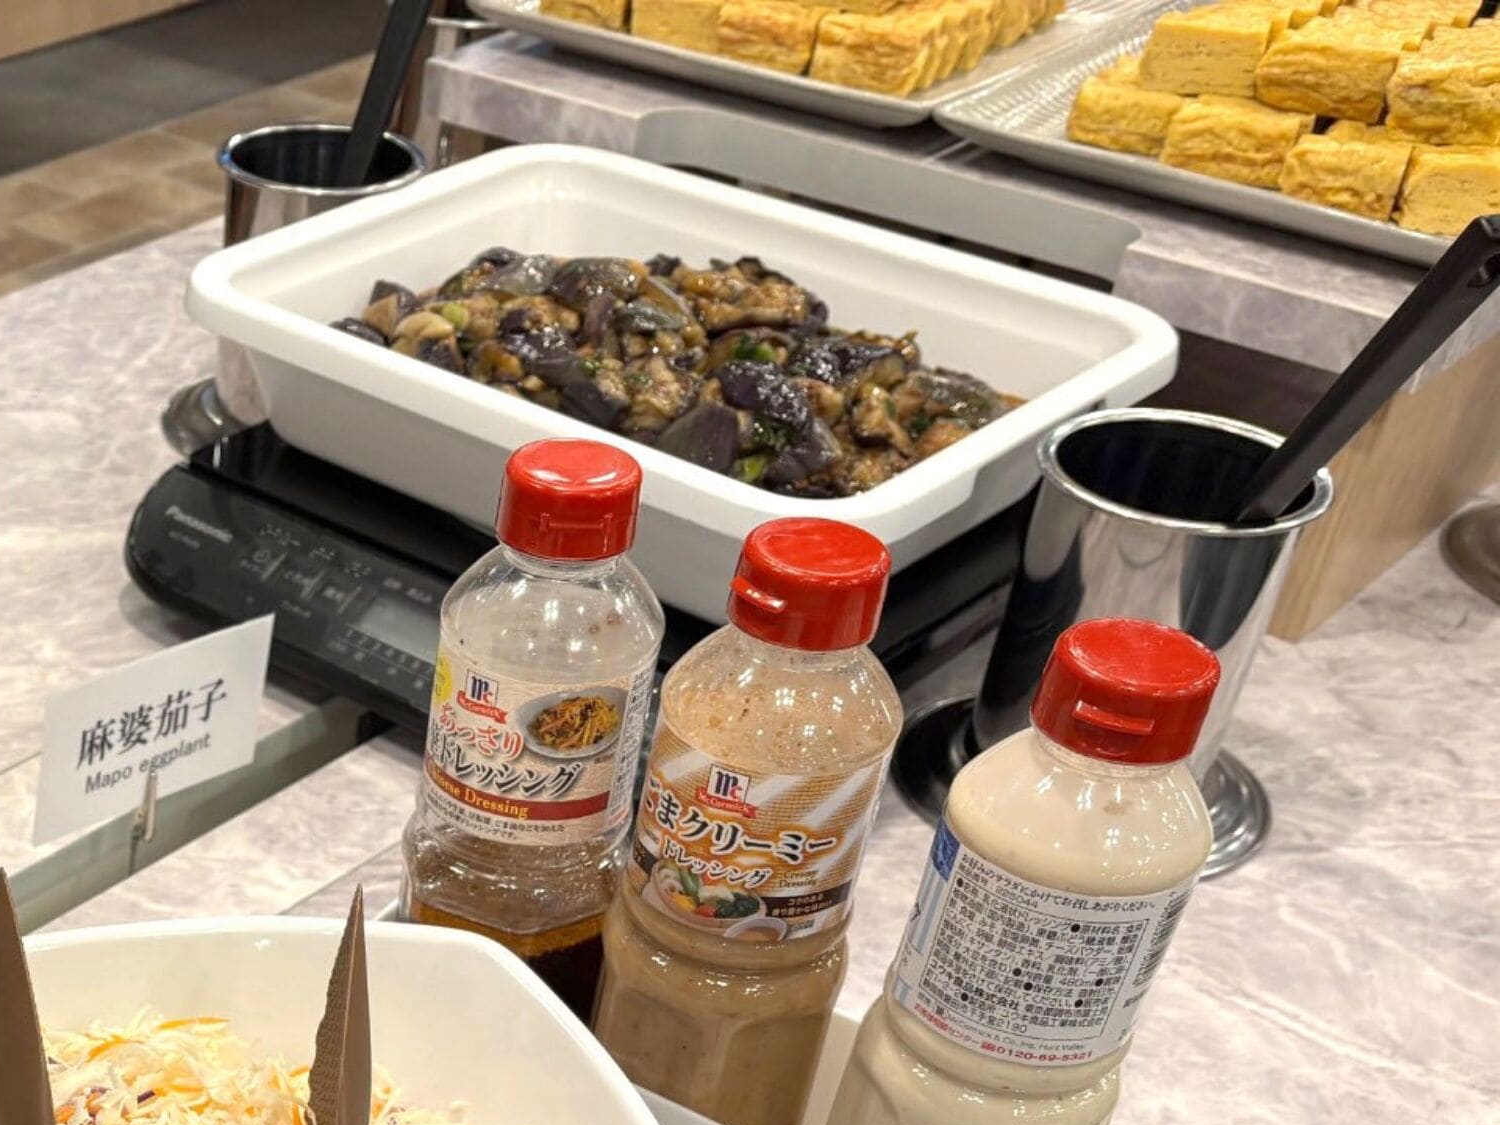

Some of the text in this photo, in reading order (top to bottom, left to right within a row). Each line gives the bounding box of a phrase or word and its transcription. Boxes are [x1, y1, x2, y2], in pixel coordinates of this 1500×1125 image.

[77, 678, 227, 770] 麻婆茄子
[439, 703, 522, 758] あっさり
[85, 732, 211, 794] Mapo eggplant
[464, 788, 530, 820] Dressing
[699, 790, 751, 812] McCormick
[665, 839, 770, 885] ドレッシング
[779, 878, 817, 888] Dressing
